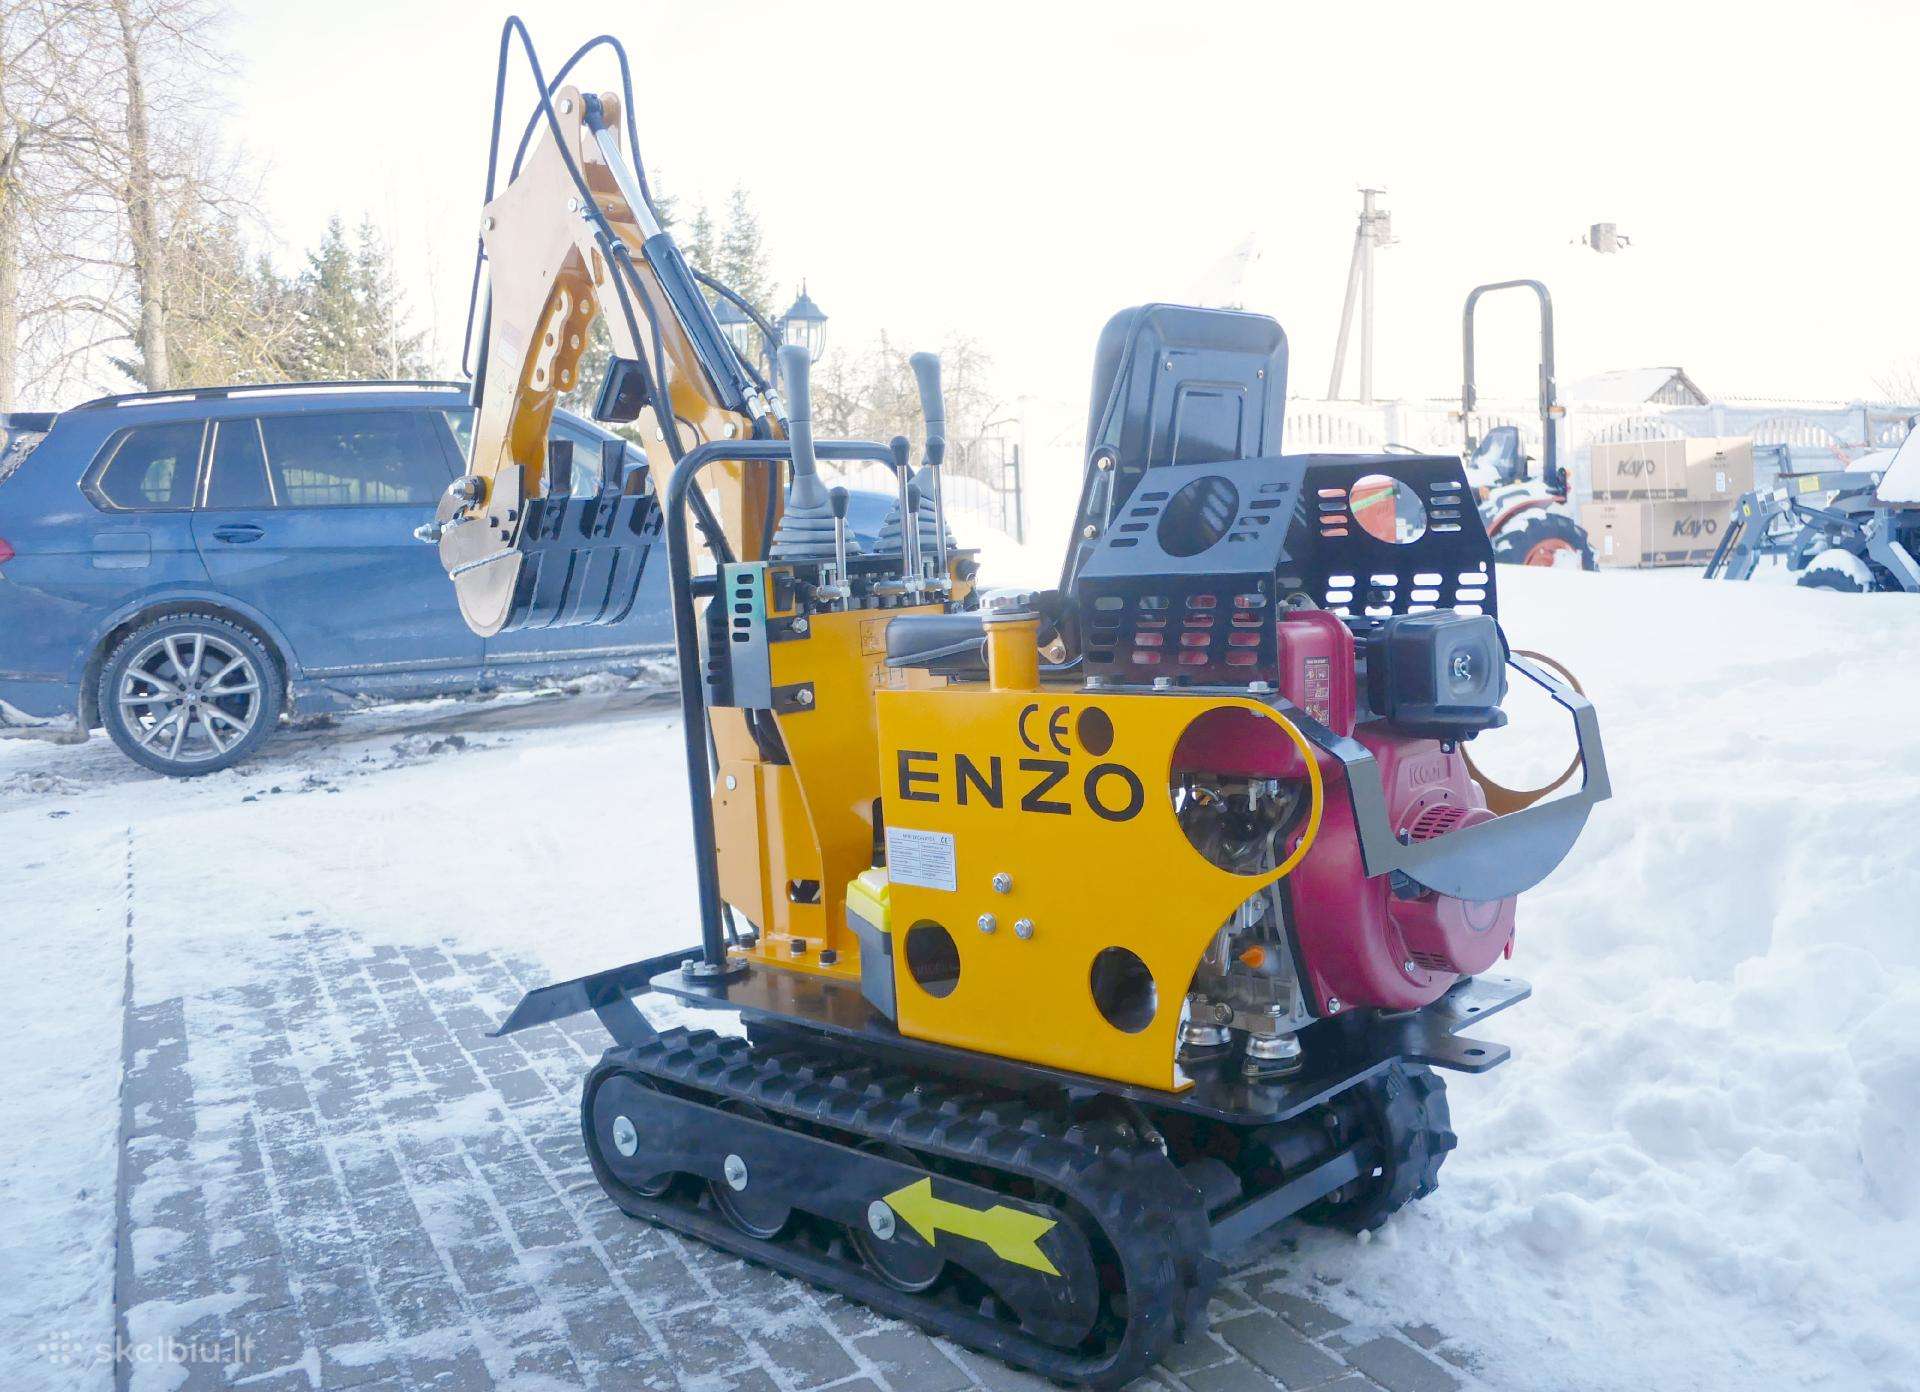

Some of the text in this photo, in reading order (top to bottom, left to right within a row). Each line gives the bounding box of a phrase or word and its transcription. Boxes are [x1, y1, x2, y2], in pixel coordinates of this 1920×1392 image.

[1617, 456, 1656, 478] KAYO
[1673, 516, 1717, 538] KAYO
[1018, 704, 1071, 756] CE
[897, 749, 1145, 822] ENZO
